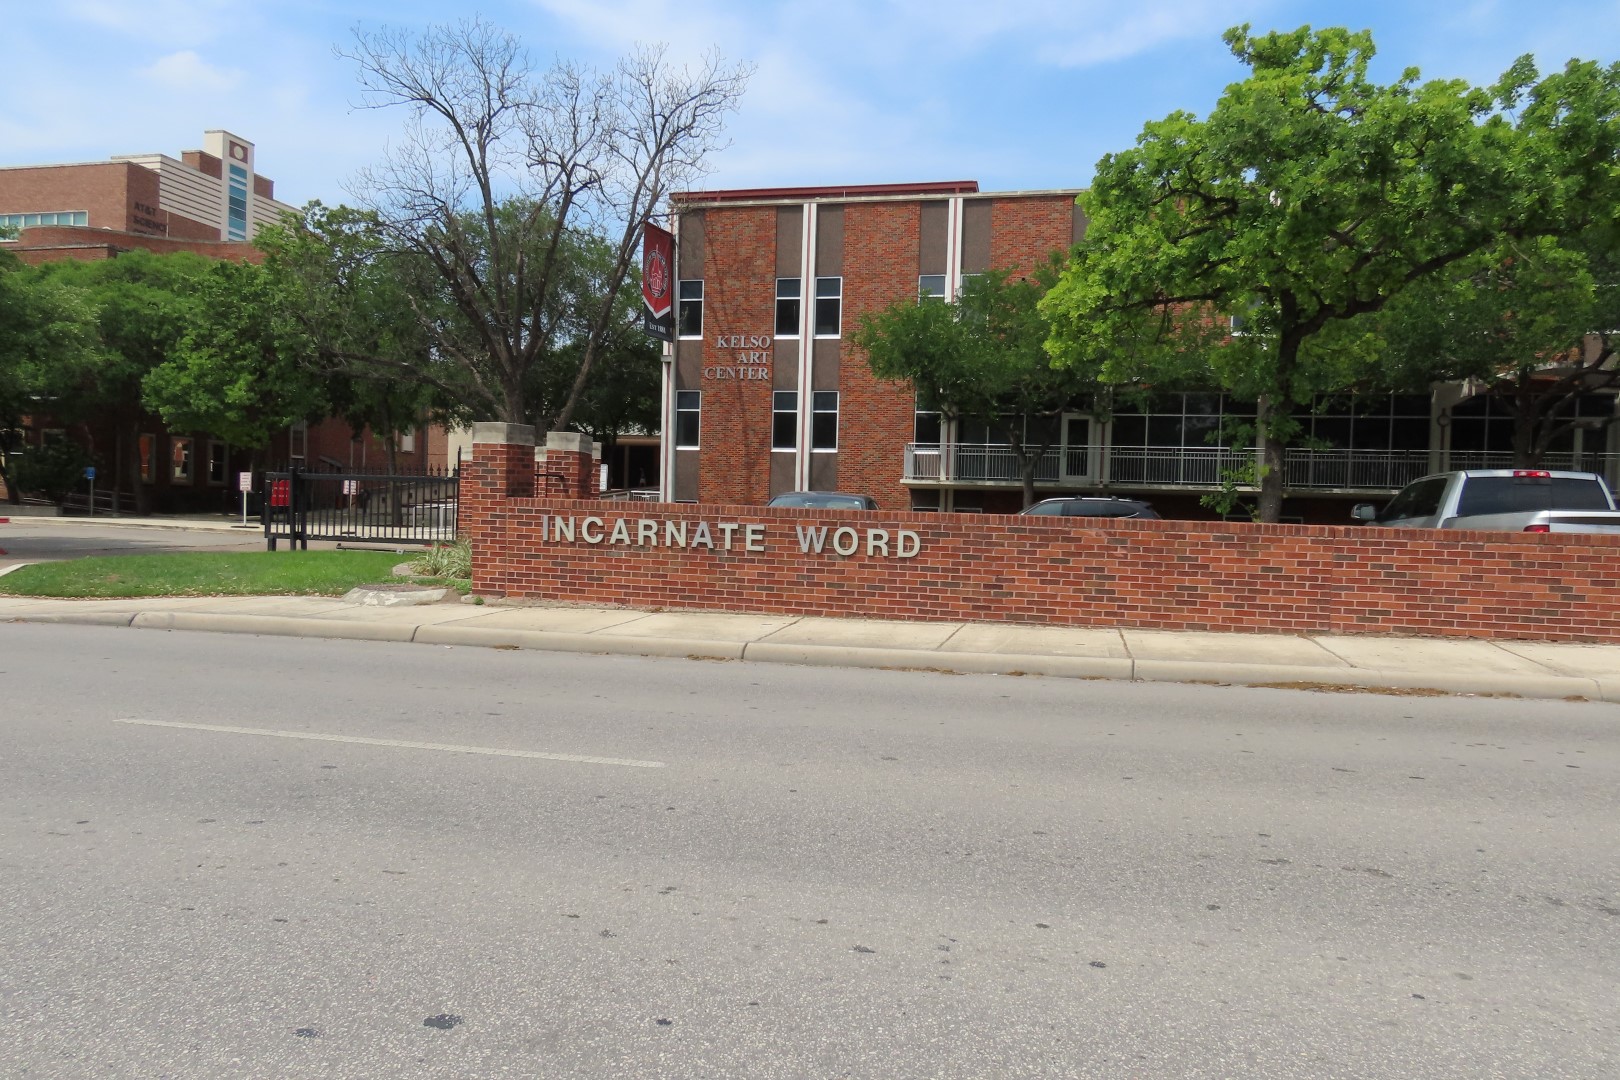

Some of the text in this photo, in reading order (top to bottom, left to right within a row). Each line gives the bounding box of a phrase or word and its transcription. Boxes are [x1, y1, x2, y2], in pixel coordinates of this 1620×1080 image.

[134, 202, 156, 216] AT&T
[717, 335, 771, 348] KELSO
[737, 351, 770, 364] ART
[704, 366, 769, 380] CENTER
[542, 514, 922, 559] INCARNATE WORD
